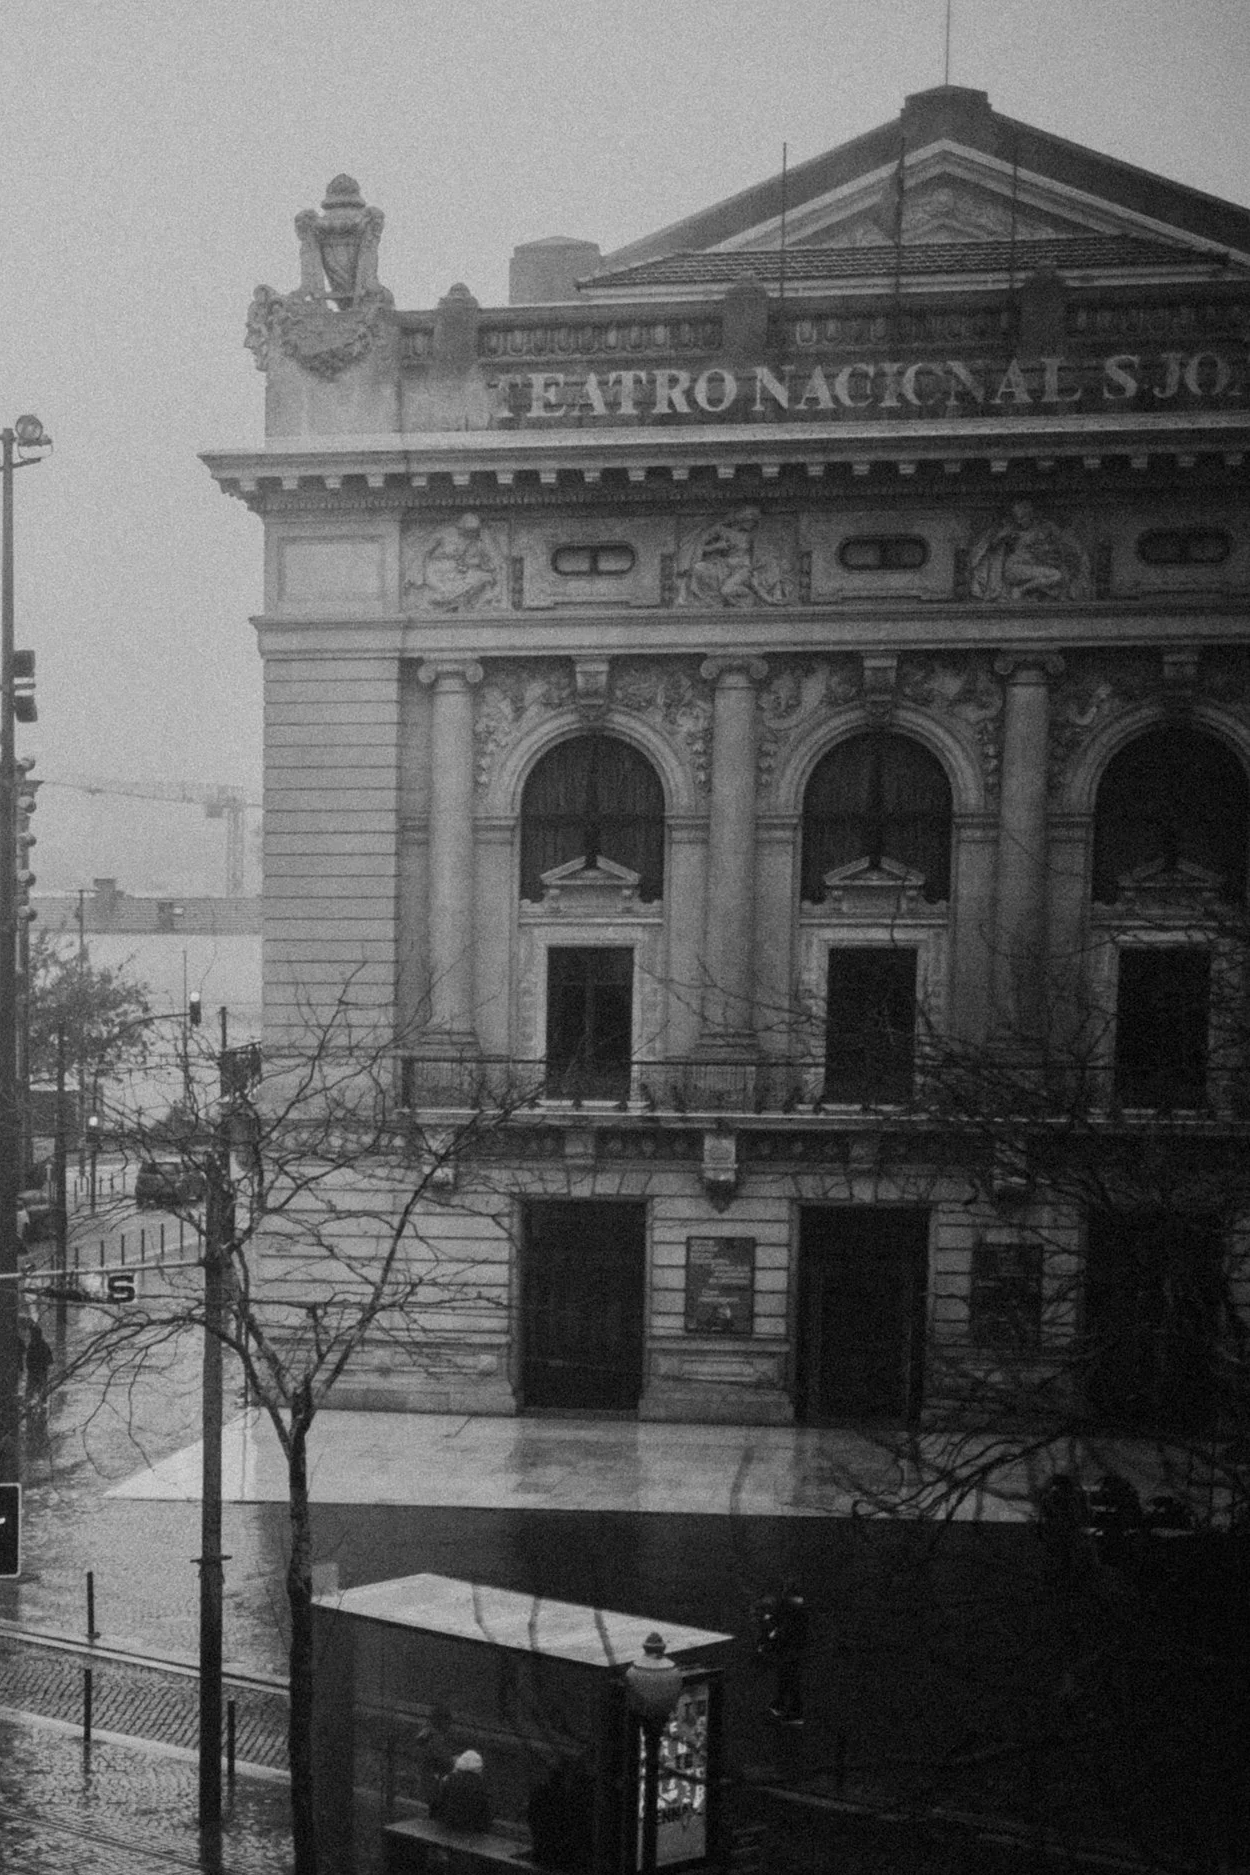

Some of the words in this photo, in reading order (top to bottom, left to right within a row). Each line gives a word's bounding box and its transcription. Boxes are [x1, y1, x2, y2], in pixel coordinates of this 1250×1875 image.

[488, 367, 738, 419] TEATRO
[750, 355, 1083, 412] NACIONAL
[1152, 350, 1249, 399] JO
